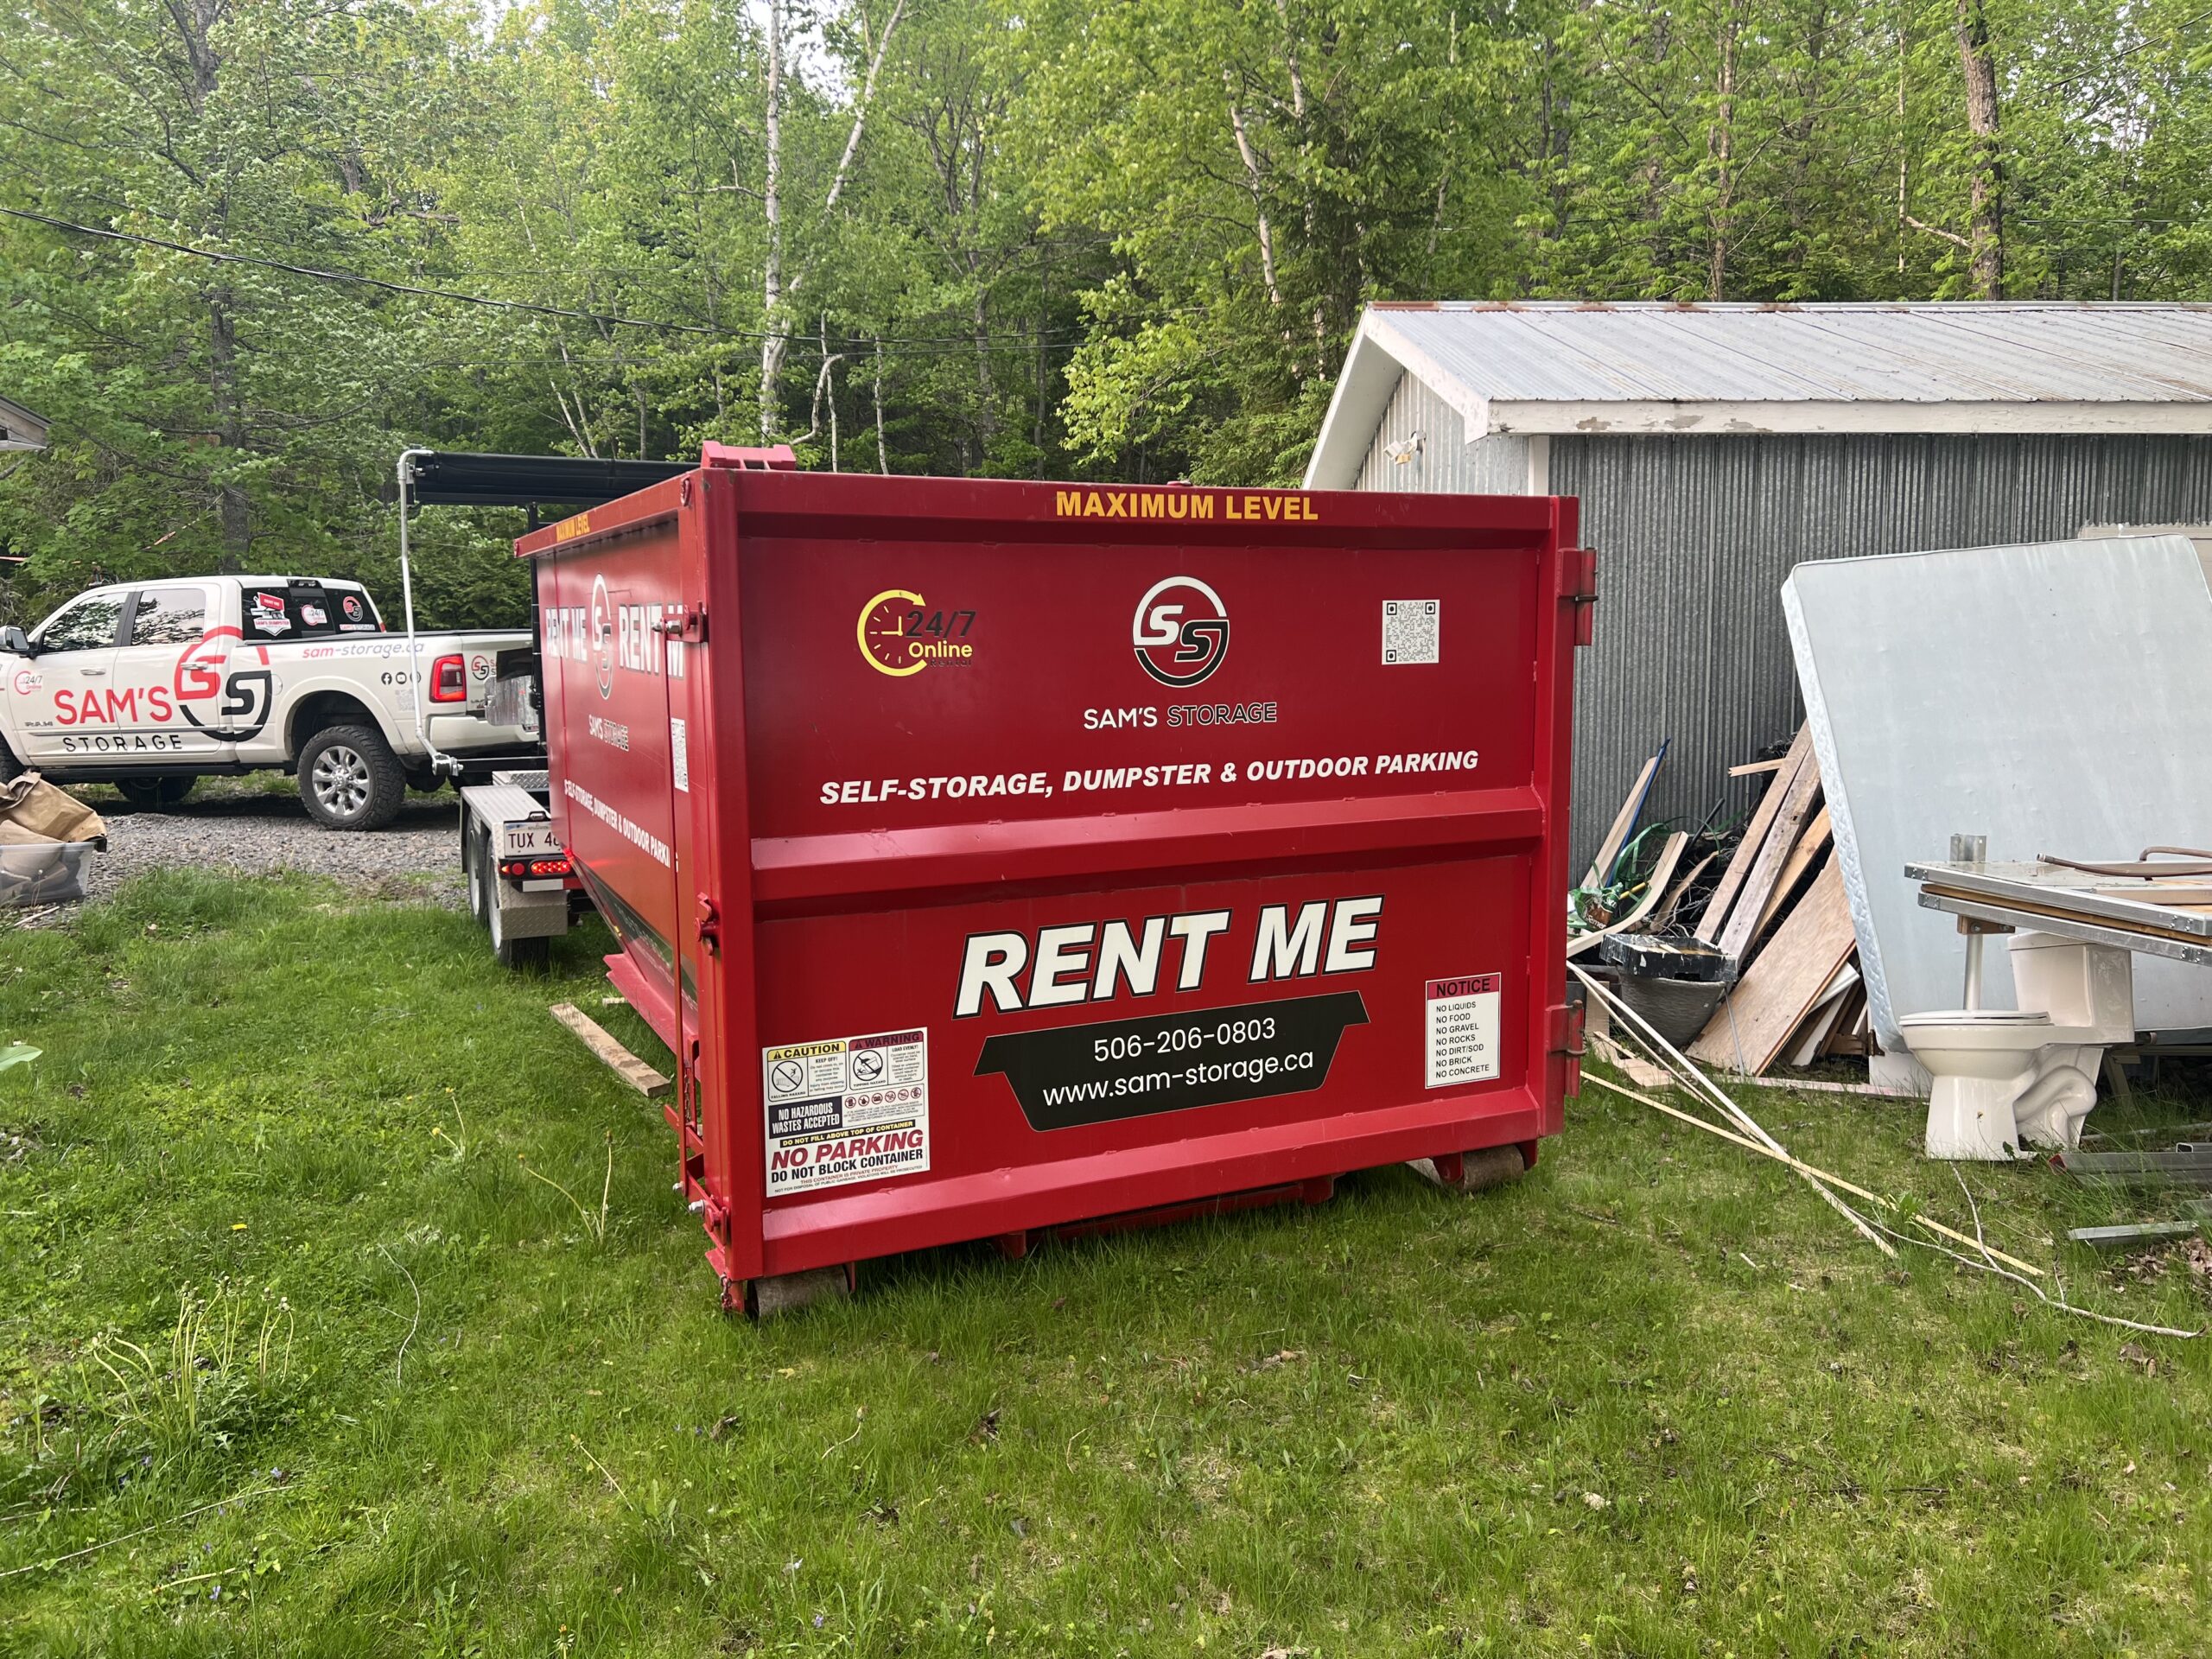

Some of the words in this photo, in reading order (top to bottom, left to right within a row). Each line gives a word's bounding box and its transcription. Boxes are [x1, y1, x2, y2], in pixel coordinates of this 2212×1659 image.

[1056, 491, 1214, 518] MAXIMUM
[1226, 496, 1319, 520] LEVEL
[546, 607, 569, 659] RENT
[571, 607, 588, 661] ME
[906, 610, 976, 639] 24/7
[619, 603, 664, 676] RENT
[664, 604, 684, 678] M
[908, 640, 973, 658] Online
[930, 659, 972, 668] Rental
[54, 686, 173, 724] SAM'S
[1084, 707, 1158, 729] SAM'S
[1166, 702, 1277, 727] STORAGE
[62, 734, 182, 752] STORAGE
[820, 772, 1052, 804] SELF-STORAGE,
[1063, 763, 1211, 792] DUMPSTER
[1220, 762, 1237, 783] &
[1246, 756, 1369, 782] OUTDOOR
[1375, 750, 1479, 774] PARKING
[508, 832, 534, 849] TUX
[623, 817, 650, 854] OUTDOOR
[954, 909, 1231, 1018] RENT
[1249, 895, 1384, 981] ME
[1437, 978, 1491, 997] NOTICE
[1448, 1001, 1476, 1011] LIQUIDS
[1449, 1013, 1471, 1022] FOOD
[1449, 1023, 1479, 1033] GRAVEL
[865, 1033, 919, 1048] WARNING
[1094, 1018, 1276, 1062] 506-206-0803
[1449, 1034, 1476, 1044] ROCKS
[784, 1044, 840, 1058] CAUTION
[1449, 1044, 1484, 1055] DIRT/SOD
[1449, 1056, 1472, 1065] BRICK
[1449, 1064, 1490, 1076] CONCRETE
[1043, 1051, 1313, 1106] www.sam-storage.ca
[779, 1109, 789, 1121] NO
[791, 1103, 833, 1119] HAZARDOUS
[772, 1119, 802, 1135] WASTES
[804, 1114, 840, 1130] ACCEPTED
[826, 1131, 849, 1140] ABOVE
[876, 1121, 913, 1132] CONTAINER
[772, 1147, 808, 1170] NO
[815, 1129, 923, 1163] PARKING
[772, 1171, 787, 1183] DO
[791, 1166, 815, 1179] NOT
[819, 1160, 857, 1175] BLOCK
[861, 1148, 923, 1168] CONTAINER
[813, 1174, 843, 1183] CONTAINER
